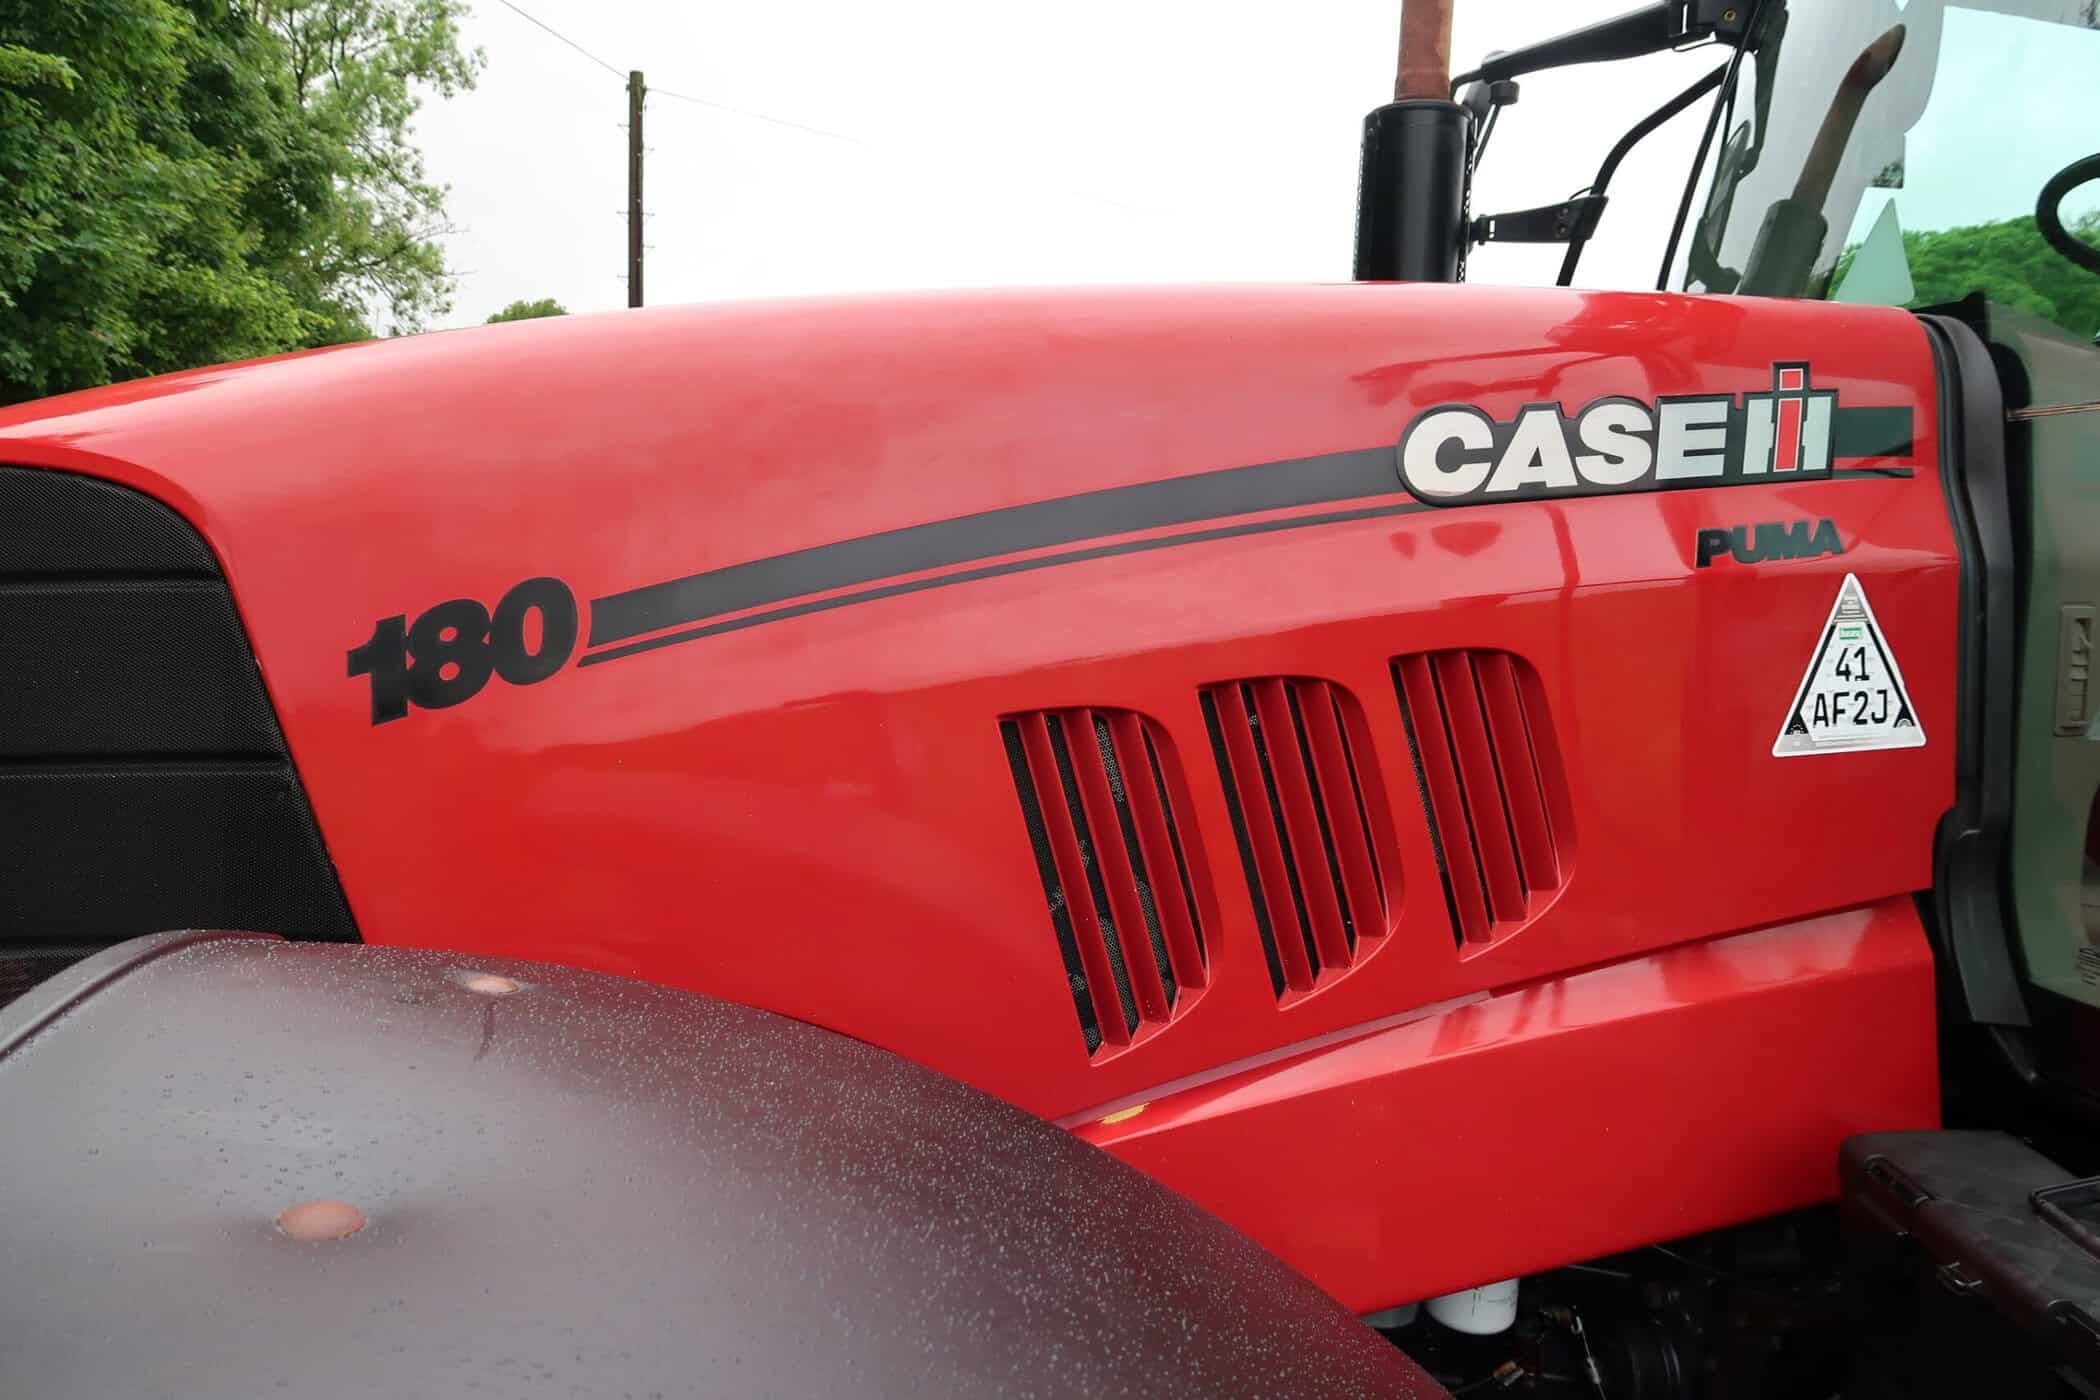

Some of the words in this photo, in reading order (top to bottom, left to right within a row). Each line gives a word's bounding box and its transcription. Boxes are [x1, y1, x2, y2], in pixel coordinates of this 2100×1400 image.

[1403, 402, 1729, 496] CASE
[1695, 519, 1846, 568] PUMA
[346, 576, 579, 727] 180
[1835, 646, 1870, 682] 41
[1812, 689, 1888, 728] AF2J
